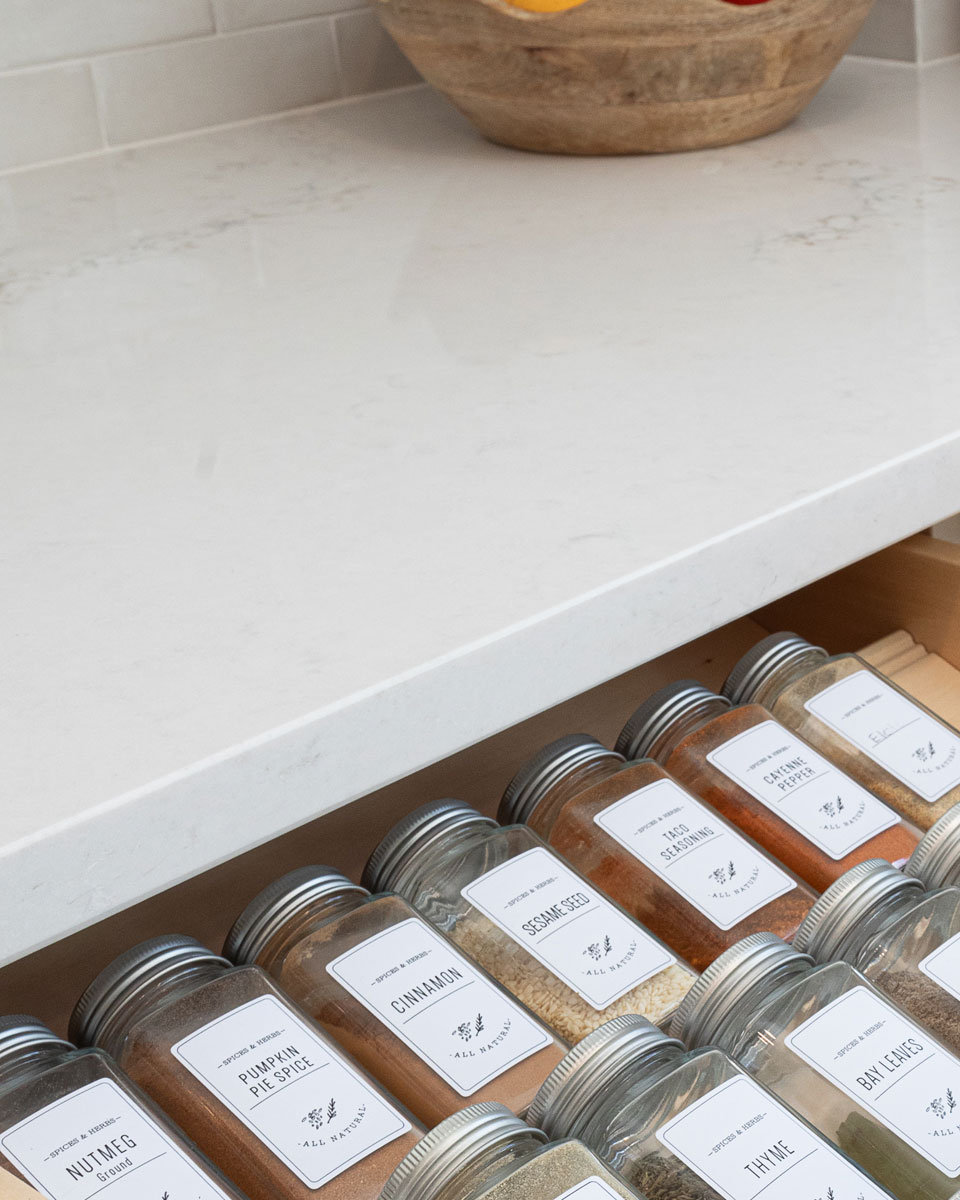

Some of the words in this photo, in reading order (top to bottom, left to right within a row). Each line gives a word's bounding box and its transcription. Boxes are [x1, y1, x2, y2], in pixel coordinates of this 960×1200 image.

[763, 757, 807, 784] CAYENNE
[777, 767, 816, 791] PEPPER
[660, 827, 714, 861] SEASONING
[662, 824, 690, 841] TACO
[522, 904, 568, 936] SESAME
[560, 892, 590, 912] SEED
[391, 967, 463, 1014] CINNAMON
[238, 1045, 300, 1085] PUMPKIN
[249, 1078, 275, 1098] PIE
[273, 1056, 314, 1082] SPICE
[856, 1065, 885, 1091] BAY
[878, 1038, 924, 1073] LEAVES
[65, 1134, 137, 1181] NUTMEG
[96, 1157, 133, 1182] Ground
[744, 1140, 795, 1179] THYME
